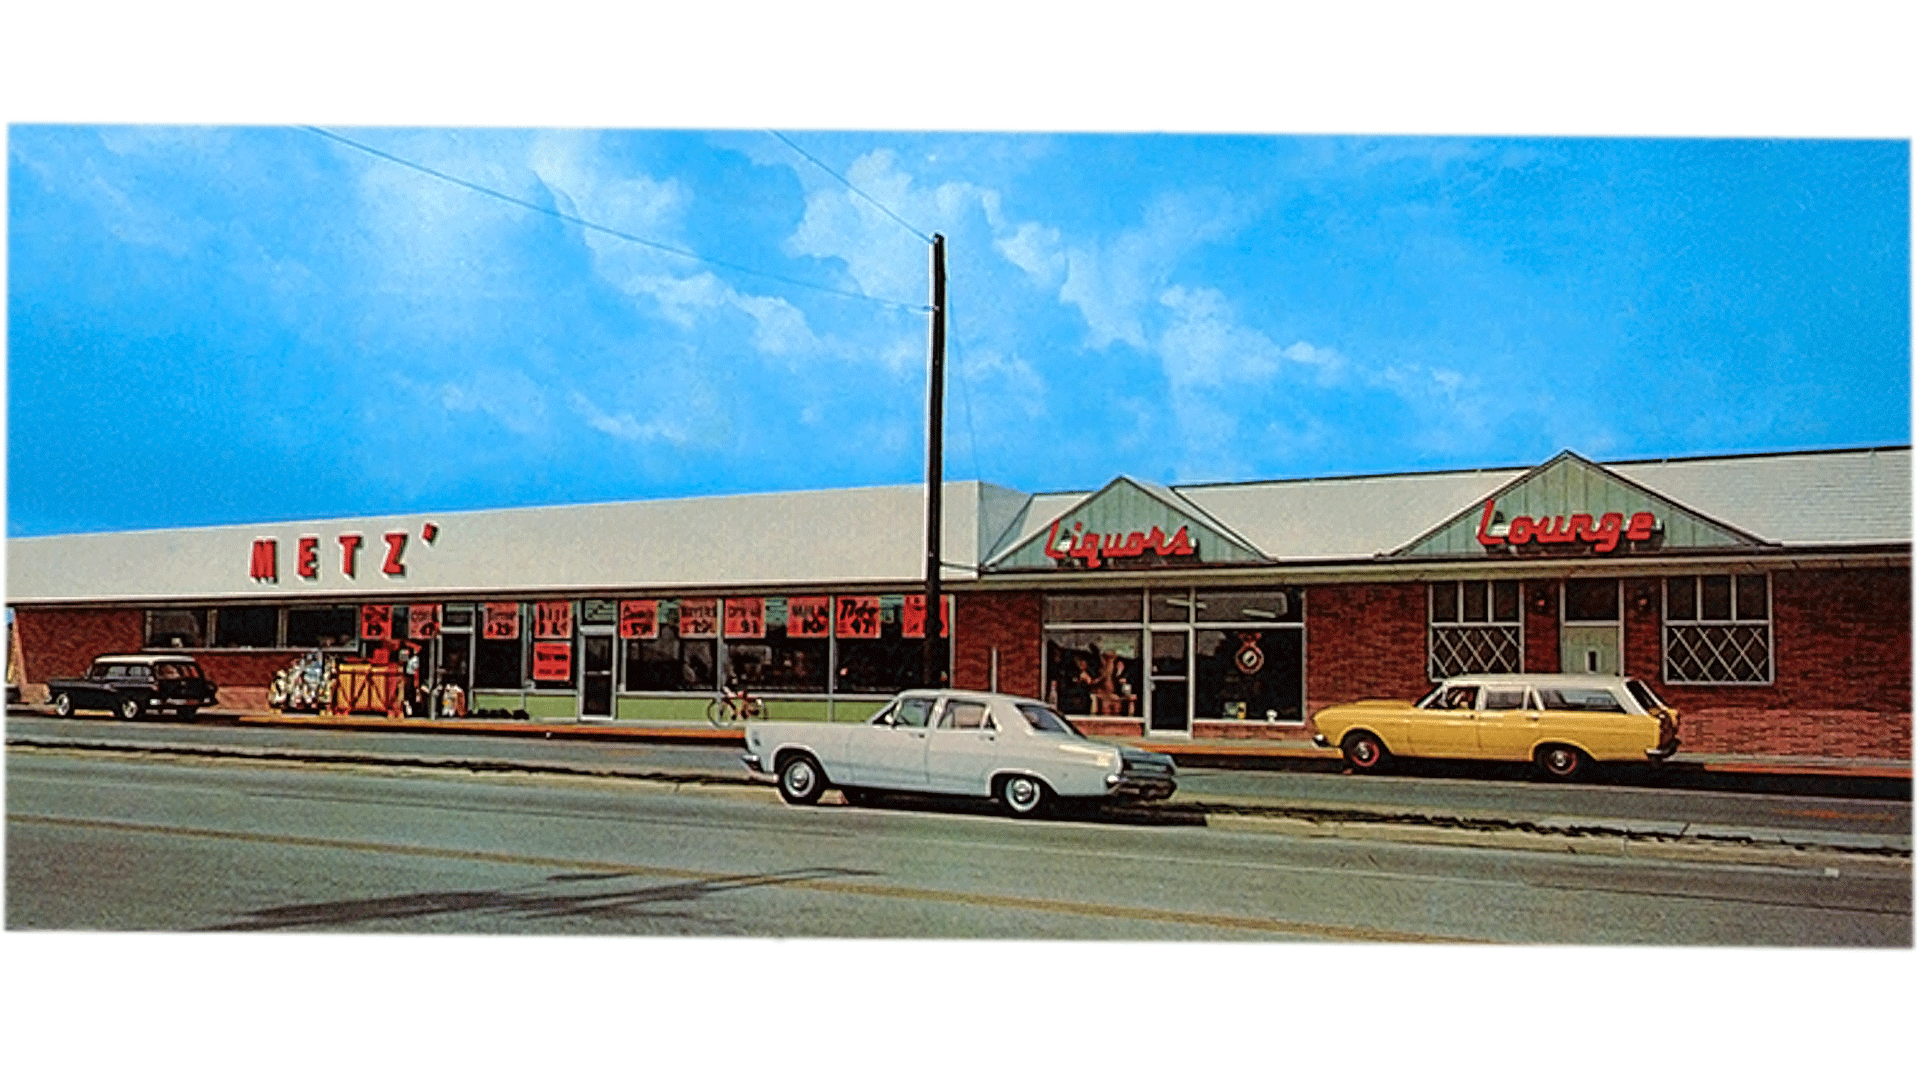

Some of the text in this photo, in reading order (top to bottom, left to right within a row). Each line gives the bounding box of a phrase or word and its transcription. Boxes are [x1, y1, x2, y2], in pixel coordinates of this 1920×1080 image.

[1045, 518, 1194, 568] Liquors
[1477, 497, 1655, 552] Lounge
[250, 522, 438, 584] METZ'
